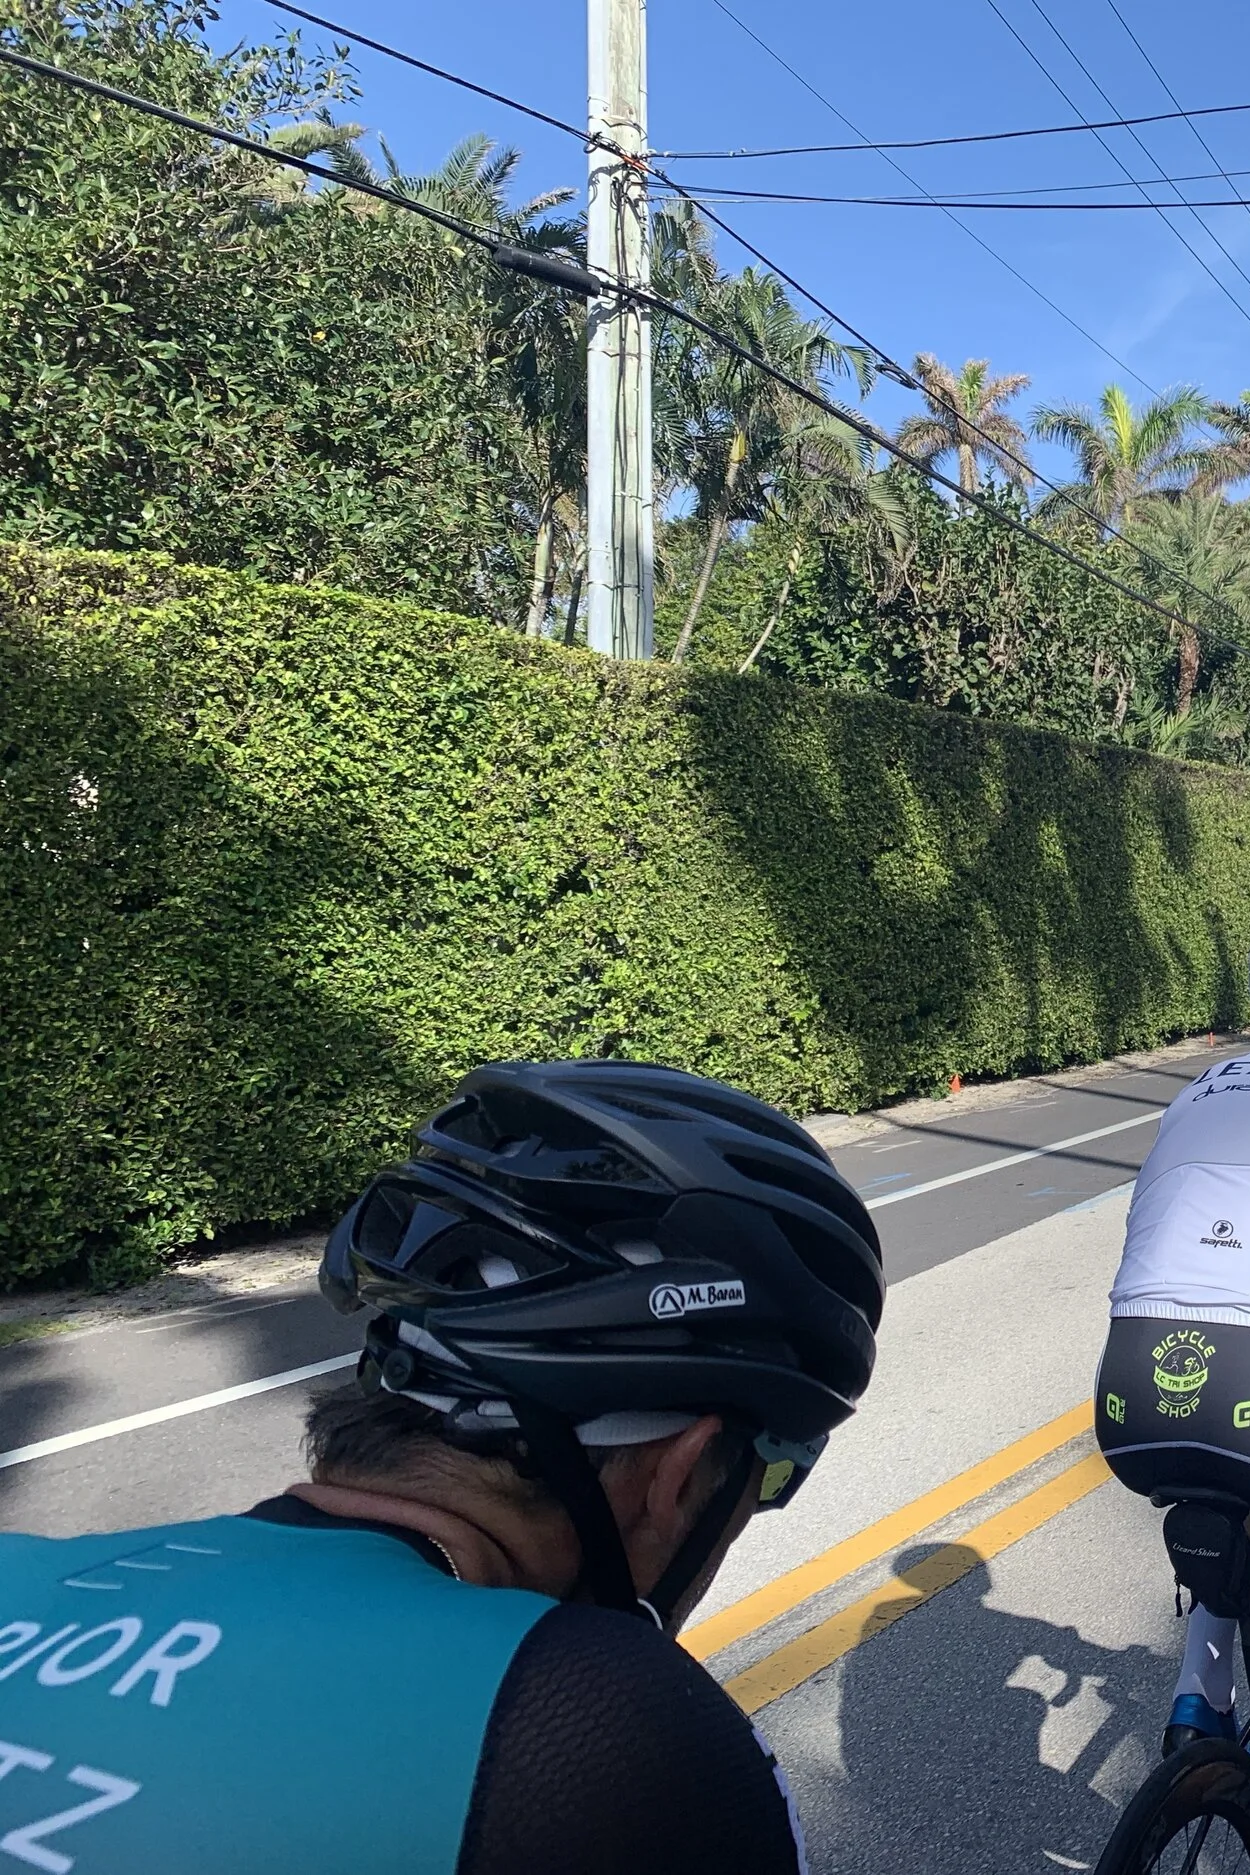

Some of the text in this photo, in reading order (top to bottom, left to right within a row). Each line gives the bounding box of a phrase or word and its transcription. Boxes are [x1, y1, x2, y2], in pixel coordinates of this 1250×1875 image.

[1152, 1329, 1217, 1361] BICYCLE
[1155, 1372, 1206, 1388] LC TRI SHOP
[1156, 1397, 1201, 1418] SHOP
